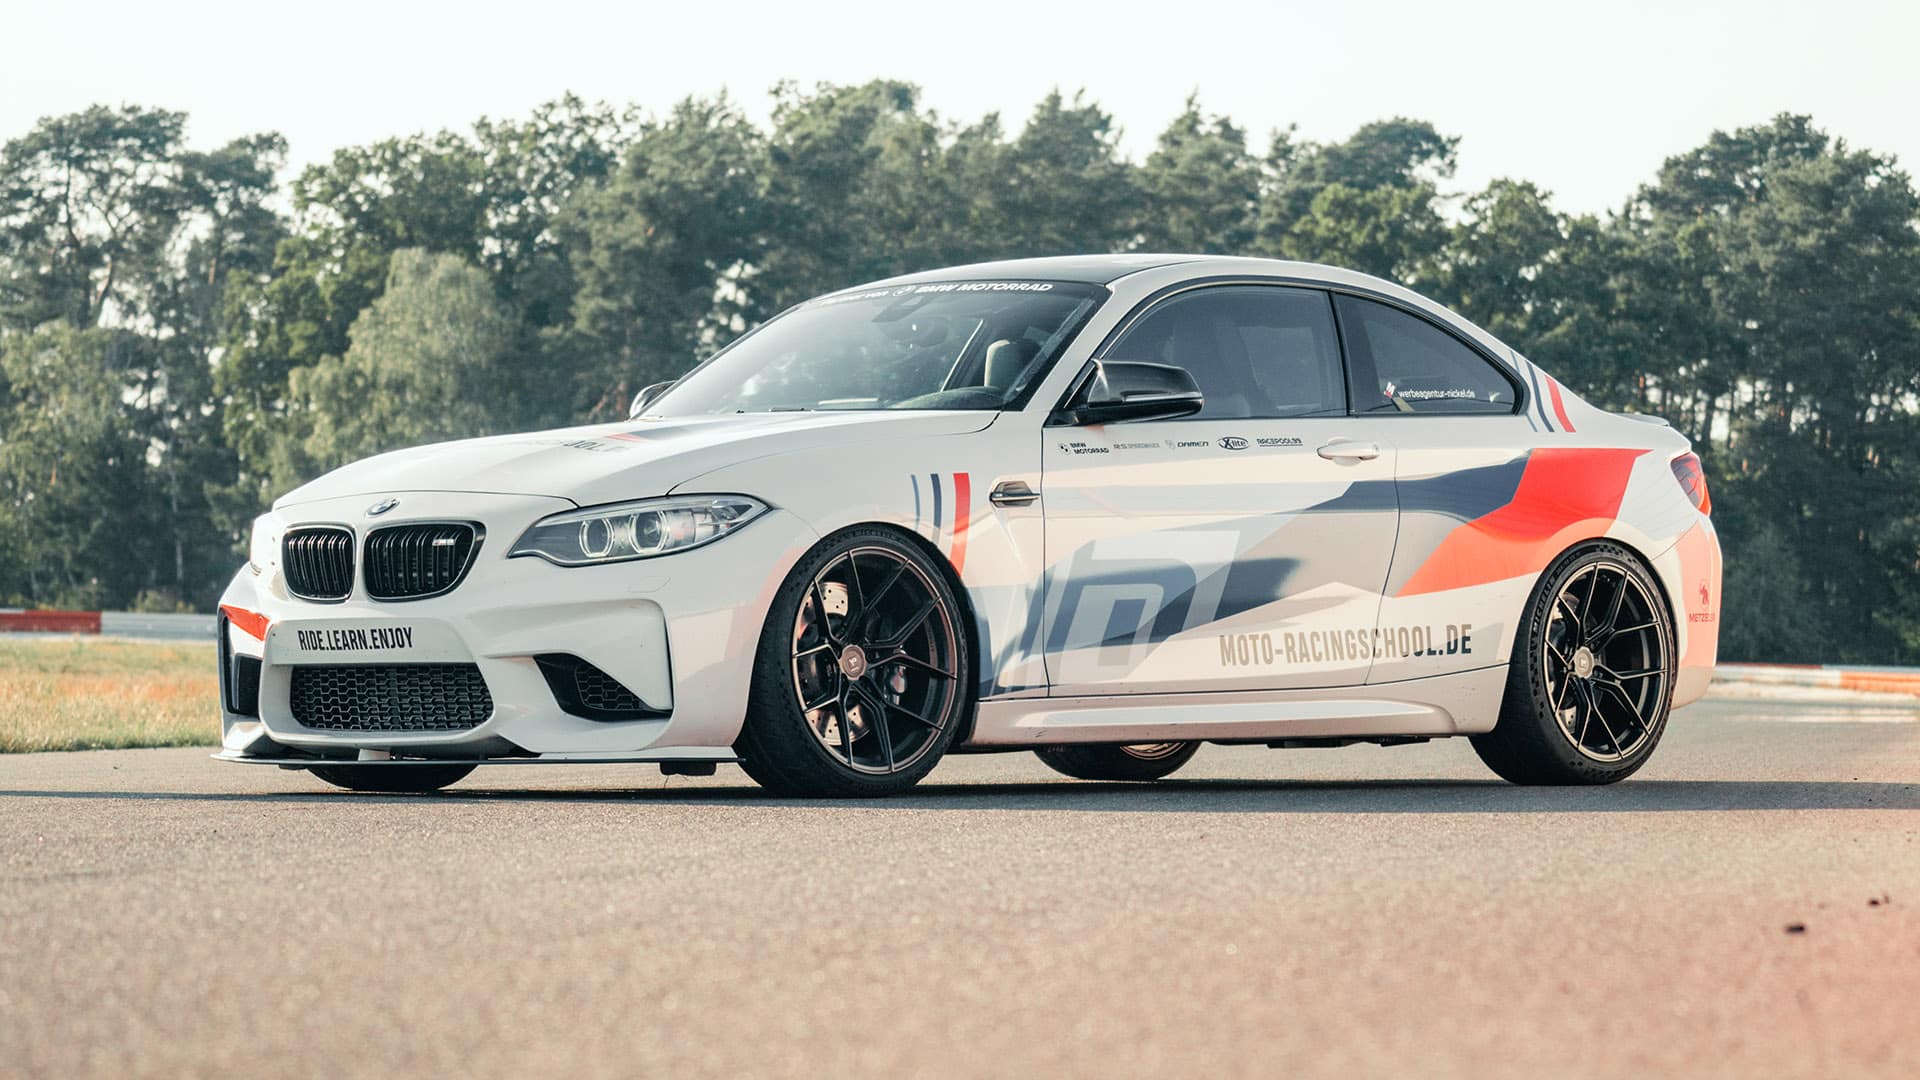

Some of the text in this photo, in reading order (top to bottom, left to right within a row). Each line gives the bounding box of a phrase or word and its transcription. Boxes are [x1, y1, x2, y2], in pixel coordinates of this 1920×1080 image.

[957, 283, 1053, 292] MOTORRAD
[297, 626, 413, 651] RIDE.LEARN.ENJOY
[1219, 623, 1472, 667] MOTO-RACINGSCHOOL.DE
